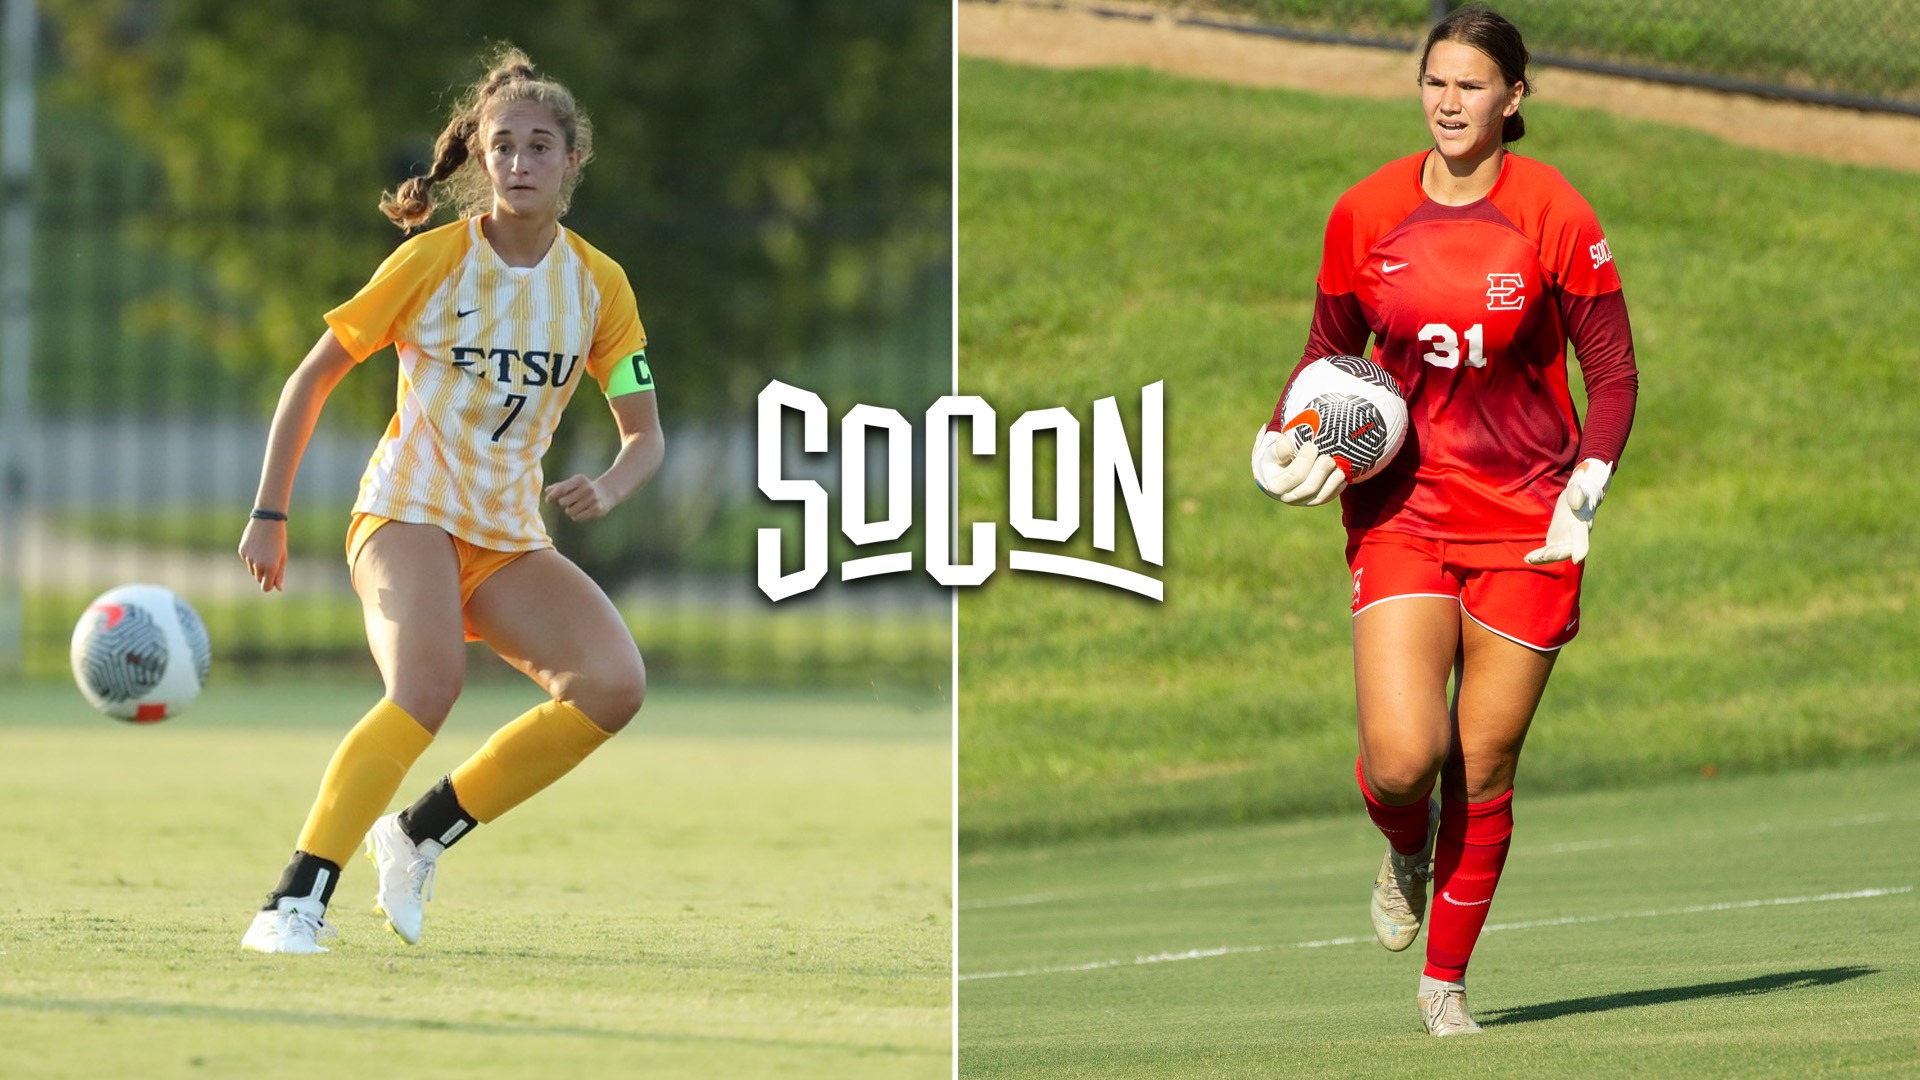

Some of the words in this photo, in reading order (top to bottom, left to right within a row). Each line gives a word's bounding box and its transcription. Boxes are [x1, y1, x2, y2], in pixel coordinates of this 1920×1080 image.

[1486, 272, 1525, 310] E
[1418, 323, 1487, 369] 31
[451, 347, 578, 388] ETSU
[632, 354, 652, 386] C
[491, 393, 527, 443] 7
